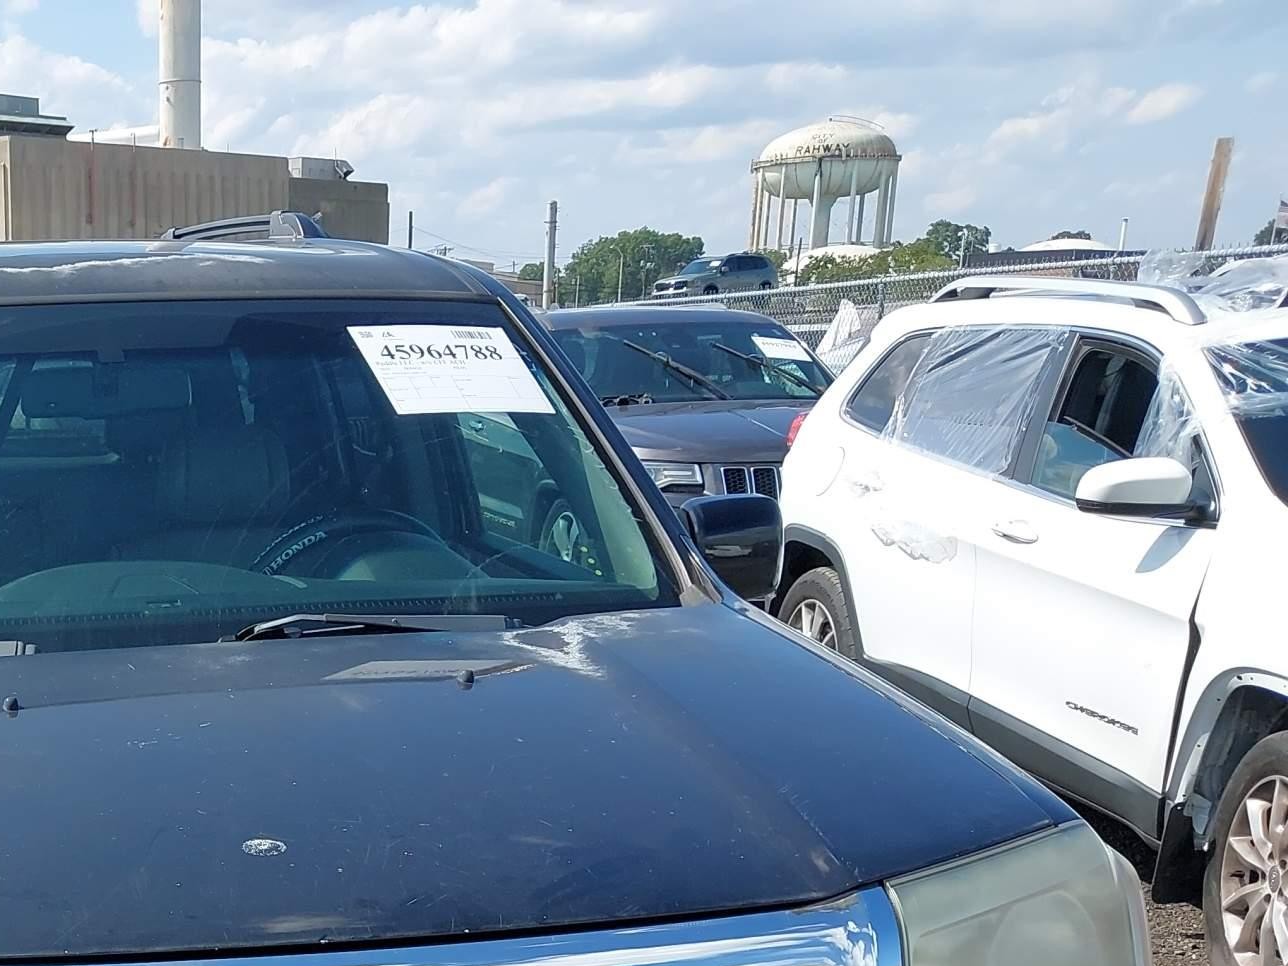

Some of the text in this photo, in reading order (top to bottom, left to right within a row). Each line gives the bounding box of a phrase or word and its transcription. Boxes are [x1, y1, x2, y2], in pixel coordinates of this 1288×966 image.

[795, 142, 850, 155] RAHWAY
[380, 343, 503, 361] 45964788
[270, 530, 327, 571] HONDA
